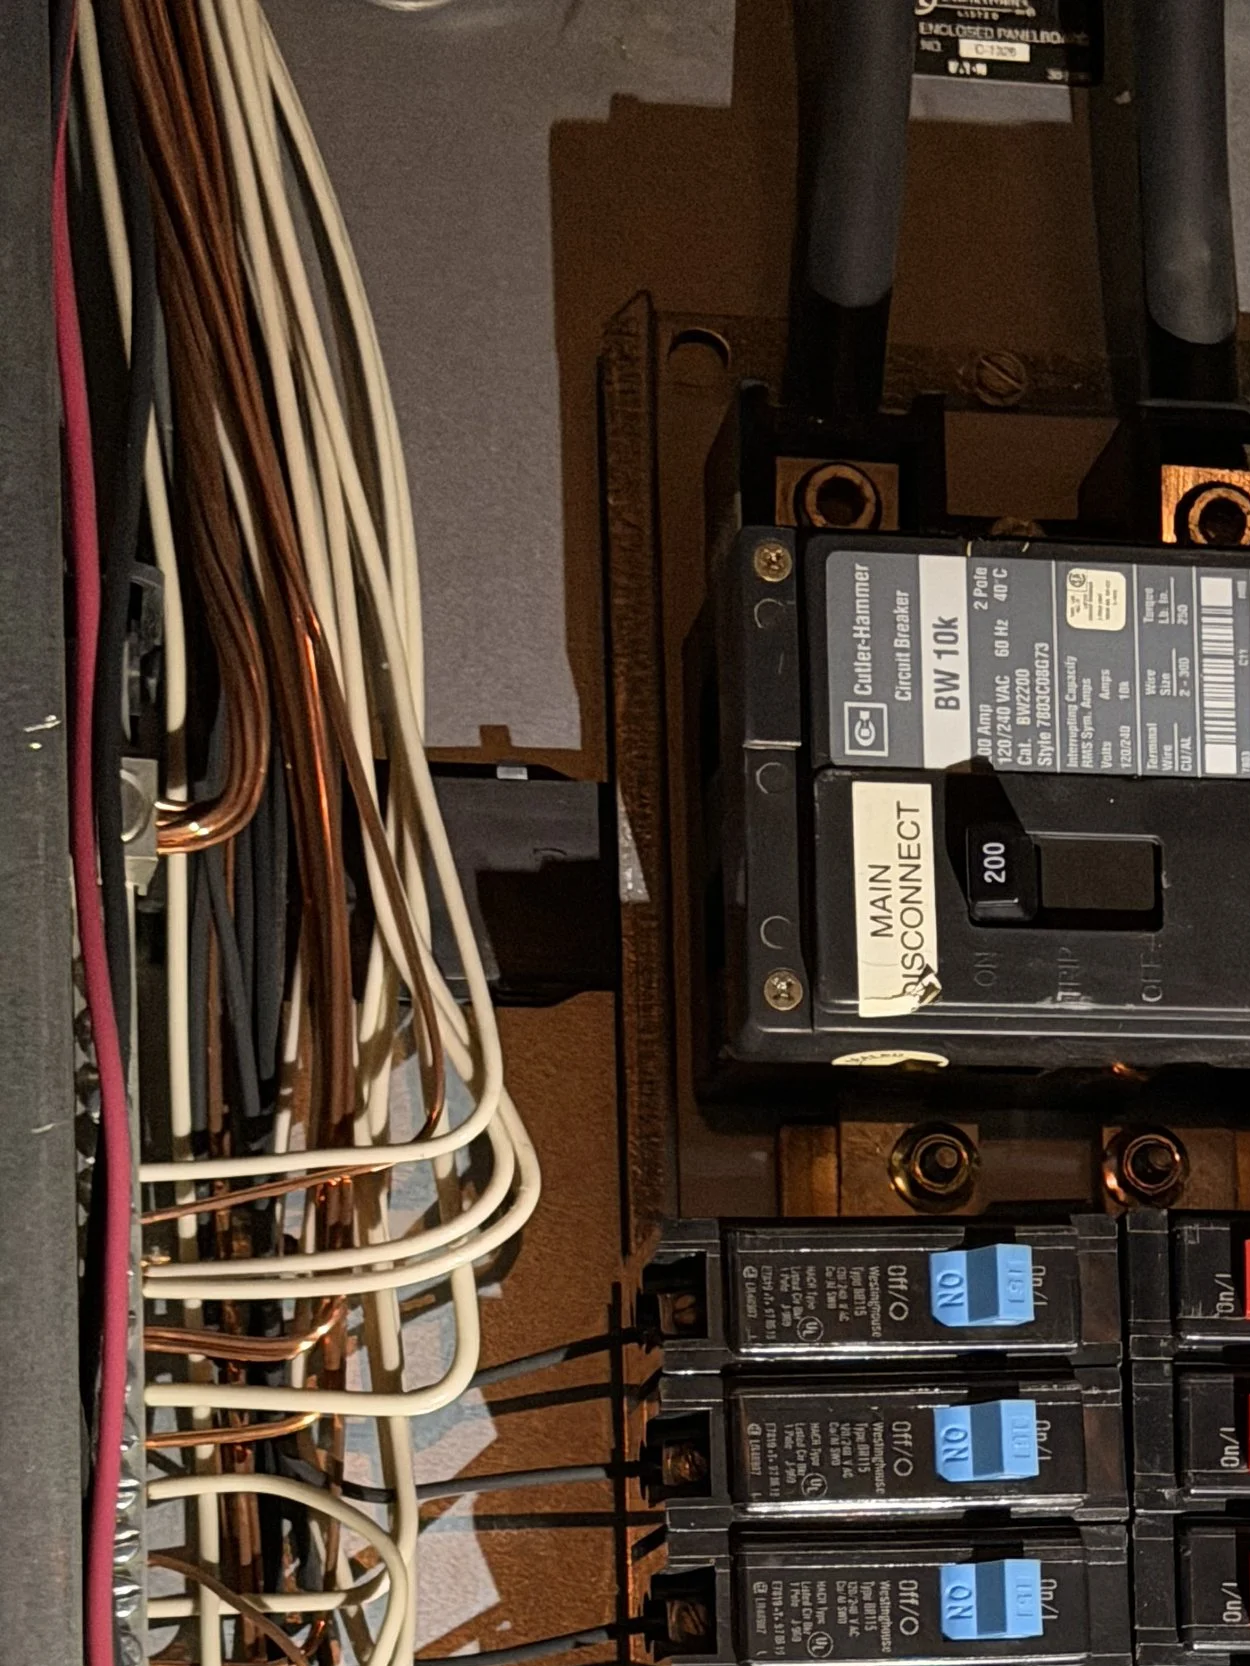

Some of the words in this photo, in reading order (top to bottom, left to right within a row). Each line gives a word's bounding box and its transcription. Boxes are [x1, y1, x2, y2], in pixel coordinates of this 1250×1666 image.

[919, 22, 994, 40] ENCLOSED
[974, 567, 988, 597] Pole
[893, 590, 911, 648] Breaker
[974, 601, 988, 610] 2
[1143, 588, 1156, 624] Torque
[853, 563, 872, 695] Cutler-Hammer
[932, 616, 959, 660] 10k
[995, 619, 1009, 636] Hz
[995, 640, 1009, 657] 60
[894, 652, 912, 701] Circuit
[934, 669, 960, 711] BW
[997, 675, 1010, 703] VAC
[1064, 655, 1077, 702] Capacity
[1080, 678, 1092, 708] Amps
[1099, 669, 1111, 700] Amps
[1145, 669, 1156, 695] Wire
[1160, 673, 1171, 696] Size
[1181, 689, 1191, 697] 2
[1016, 669, 1031, 726] BW2200
[977, 704, 993, 735] Amp
[998, 707, 1012, 765] 120/240
[1067, 704, 1079, 768] Interrupting
[1081, 712, 1094, 740] Sym.
[1018, 738, 1032, 765] Cat.
[1037, 731, 1054, 767] Style
[1082, 741, 1094, 768] RMS
[1101, 741, 1112, 769] Volts
[1121, 725, 1132, 769] 120/240
[1147, 723, 1158, 770] Terminal
[1162, 744, 1173, 771] Wire
[1180, 736, 1192, 772] CU/AL
[982, 841, 1006, 884] 200
[868, 863, 894, 938] MAIN
[896, 800, 924, 992] DISCONNECT
[974, 951, 996, 987] ON
[1058, 947, 1082, 1001] TRIP
[1142, 953, 1163, 1002] OFF
[868, 1266, 882, 1338] Westinghouse
[937, 1273, 963, 1308] ON
[872, 1422, 886, 1494] Westinghouse
[940, 1428, 969, 1463] ON
[880, 1580, 893, 1653] Westinghouse
[947, 1585, 972, 1620] ON
